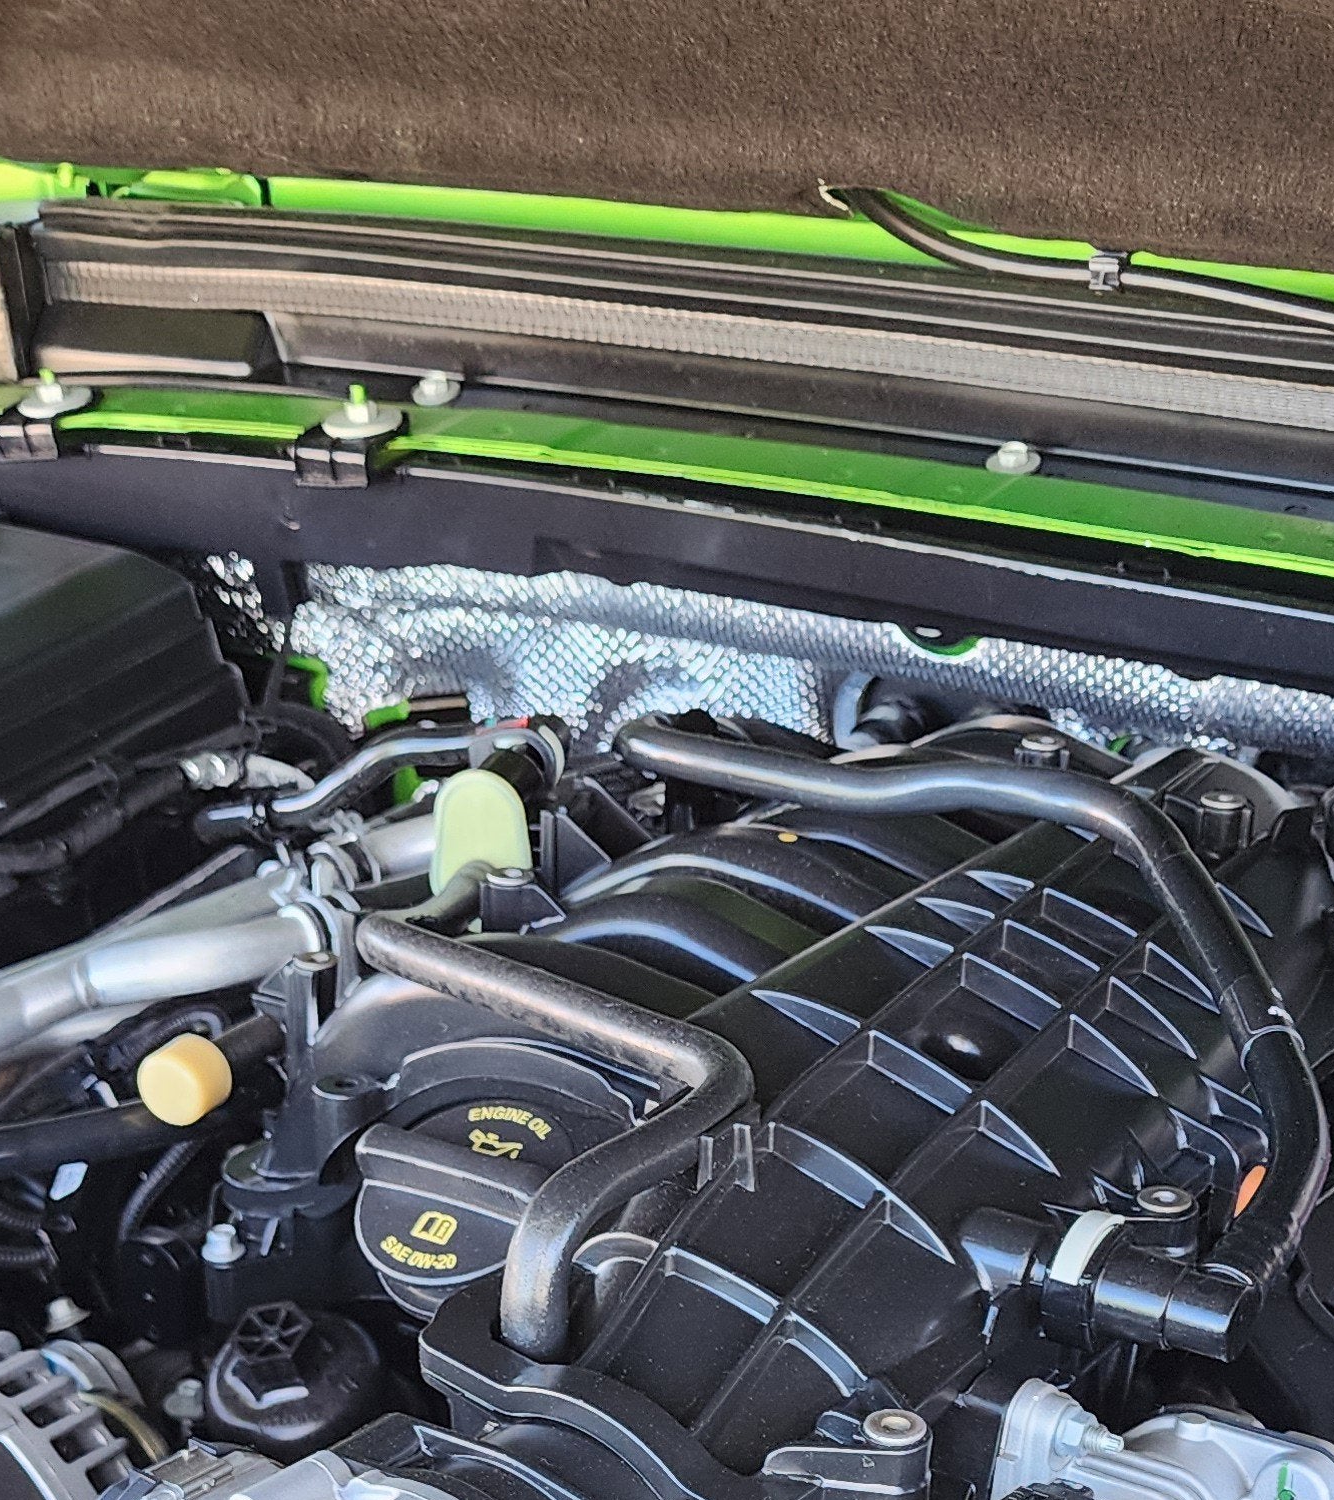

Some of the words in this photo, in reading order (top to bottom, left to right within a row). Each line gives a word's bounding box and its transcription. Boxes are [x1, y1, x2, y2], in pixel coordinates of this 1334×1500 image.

[467, 1105, 535, 1126] ENGINE
[527, 1115, 552, 1141] OIL
[379, 1234, 409, 1265] SAE
[407, 1250, 459, 1271] 0W-20
